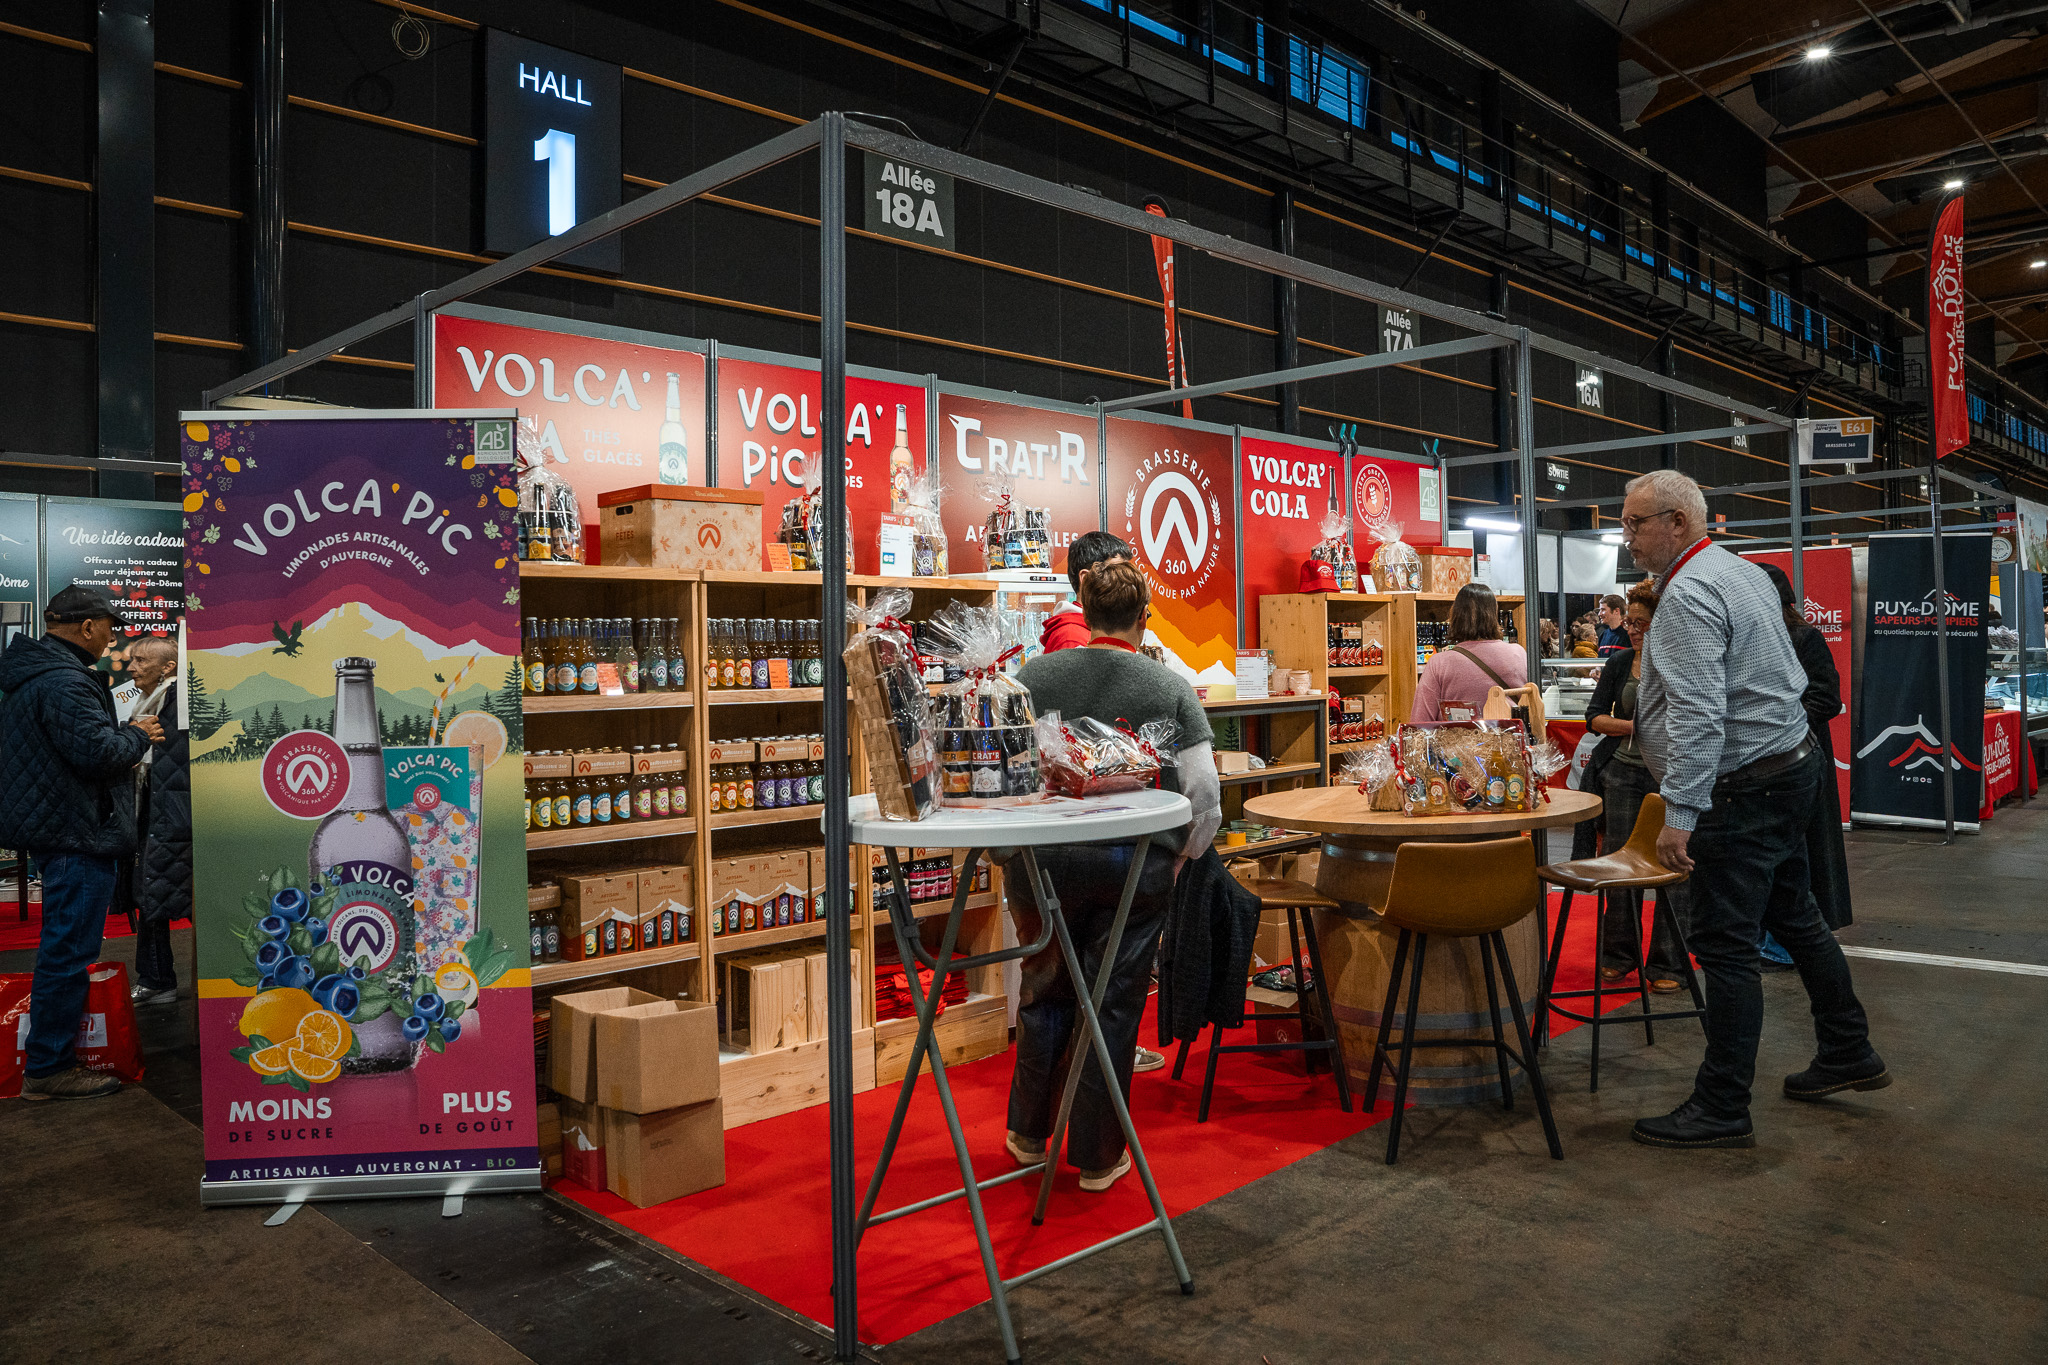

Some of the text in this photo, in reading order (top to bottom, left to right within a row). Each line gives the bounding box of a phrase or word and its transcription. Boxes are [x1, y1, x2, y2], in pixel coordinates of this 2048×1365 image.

[519, 62, 592, 106] HALL
[534, 129, 575, 236] 1
[880, 161, 936, 195] Allée
[876, 188, 945, 237] 18A
[1385, 310, 1411, 330] Allée
[1383, 328, 1414, 352] 17A
[456, 346, 650, 411] VOLCA'
[1579, 385, 1600, 409] 16A
[738, 387, 883, 446] VOLA'
[1846, 422, 1865, 433] E61
[479, 431, 505, 449] AB
[583, 427, 621, 445] THÉS
[949, 414, 1089, 481] CRAT'R
[583, 448, 643, 467] GLACÉS
[1136, 448, 1210, 490] BRASSERIE
[1248, 454, 1327, 489] VOLCA'
[1548, 466, 1569, 480] SORTIE
[1250, 488, 1310, 520] COLA
[233, 479, 400, 556] VOLCA'
[62, 527, 99, 546] Une
[101, 530, 132, 546] idée
[83, 556, 113, 565] Offrez
[128, 557, 145, 565] bon
[146, 558, 178, 566] cadeau
[282, 532, 430, 578] LIMONADES ARTISANALES
[320, 551, 393, 570] D'AUVERGNE
[117, 568, 155, 577] déjeuner
[1129, 536, 1177, 600] VOLCANIQUE
[1180, 585, 1196, 599] PAR
[1197, 544, 1220, 589] NATURE
[1165, 559, 1187, 575] 360
[73, 577, 183, 588] Sommet du Puy-de-Dôme
[153, 598, 179, 608] FÊTES
[134, 623, 177, 632] D'ACHAT
[1883, 628, 1914, 636] quotidien
[1915, 629, 1930, 637] pour
[1951, 629, 1979, 637] sécurité
[283, 744, 331, 761] BRASSERIE
[972, 751, 1000, 760] CRAT'R
[278, 780, 337, 805] VOLCANIQUE PAR NATURE
[346, 889, 396, 907] LIMONADE
[228, 1090, 512, 1123] MOINS PLUS
[229, 1117, 515, 1143] DE SUCRE DE GOÛT
[229, 1157, 517, 1180] ARTISANAL AUVERGNAT BIO
